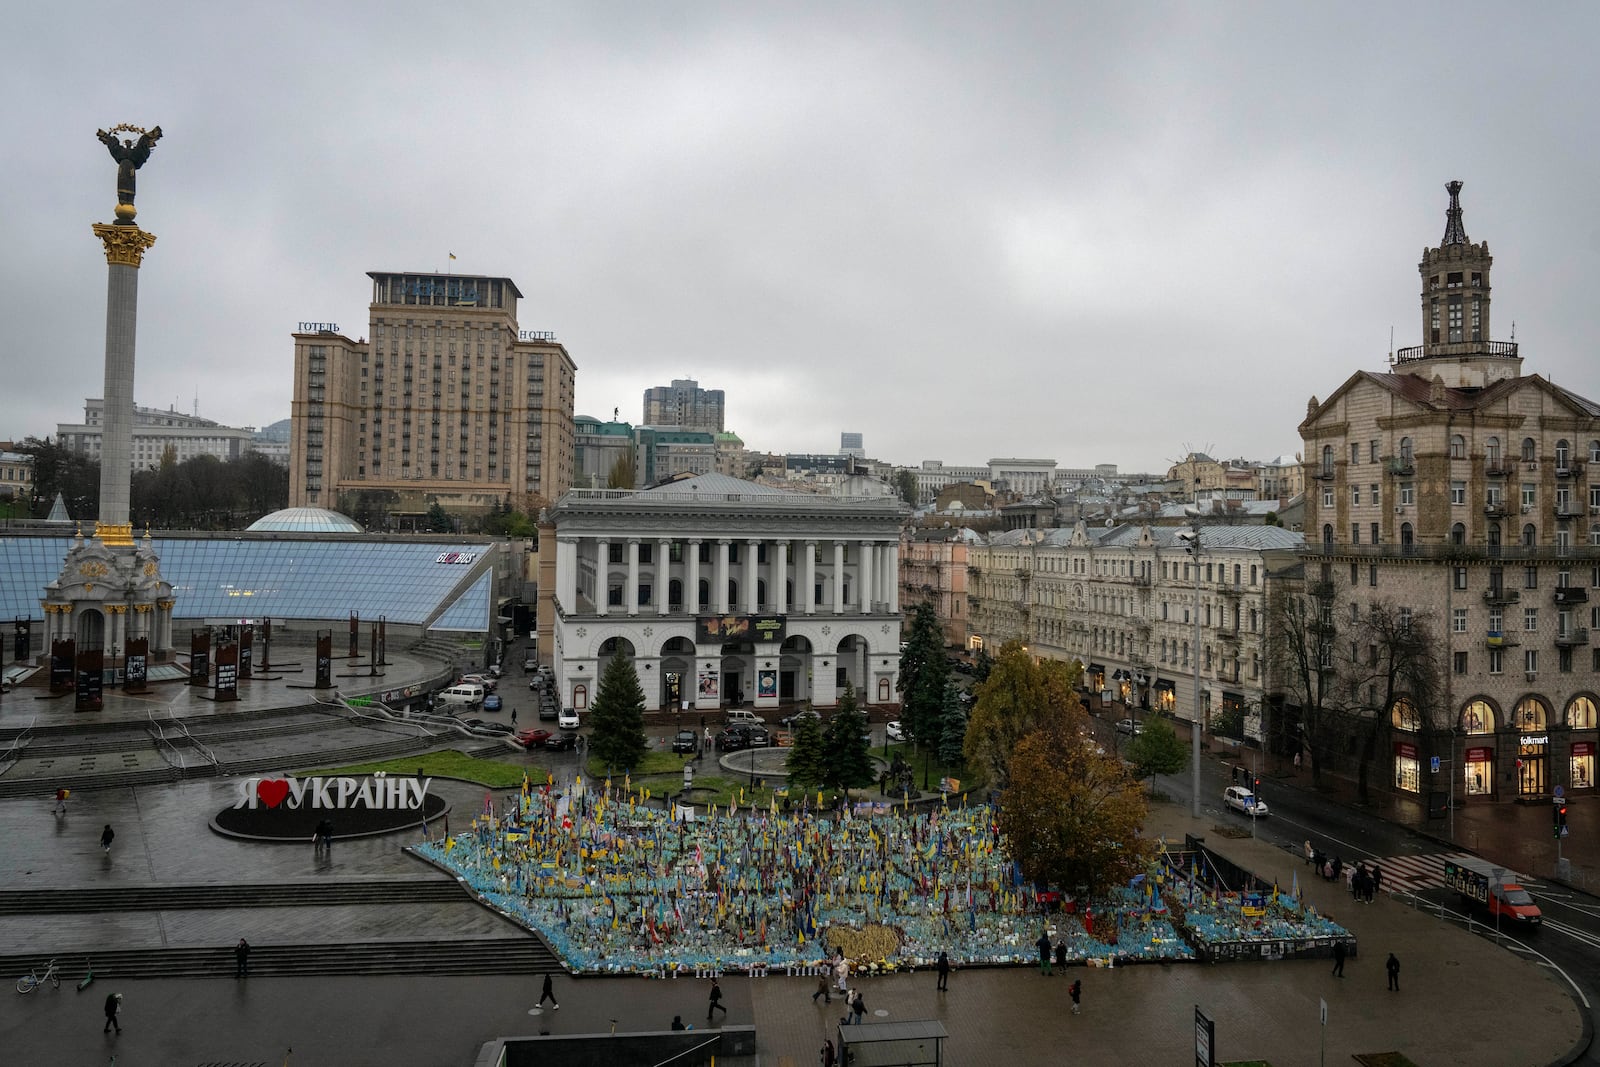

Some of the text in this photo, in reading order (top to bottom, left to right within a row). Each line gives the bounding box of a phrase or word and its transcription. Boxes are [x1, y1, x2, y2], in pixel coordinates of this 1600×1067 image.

[298, 321, 340, 331] ГОТЕЛЬ
[519, 330, 557, 340] HOTEL
[436, 552, 476, 564] GLOBUS
[1520, 736, 1549, 746] folkmart
[233, 771, 432, 809] Я УКРАЇНУ
